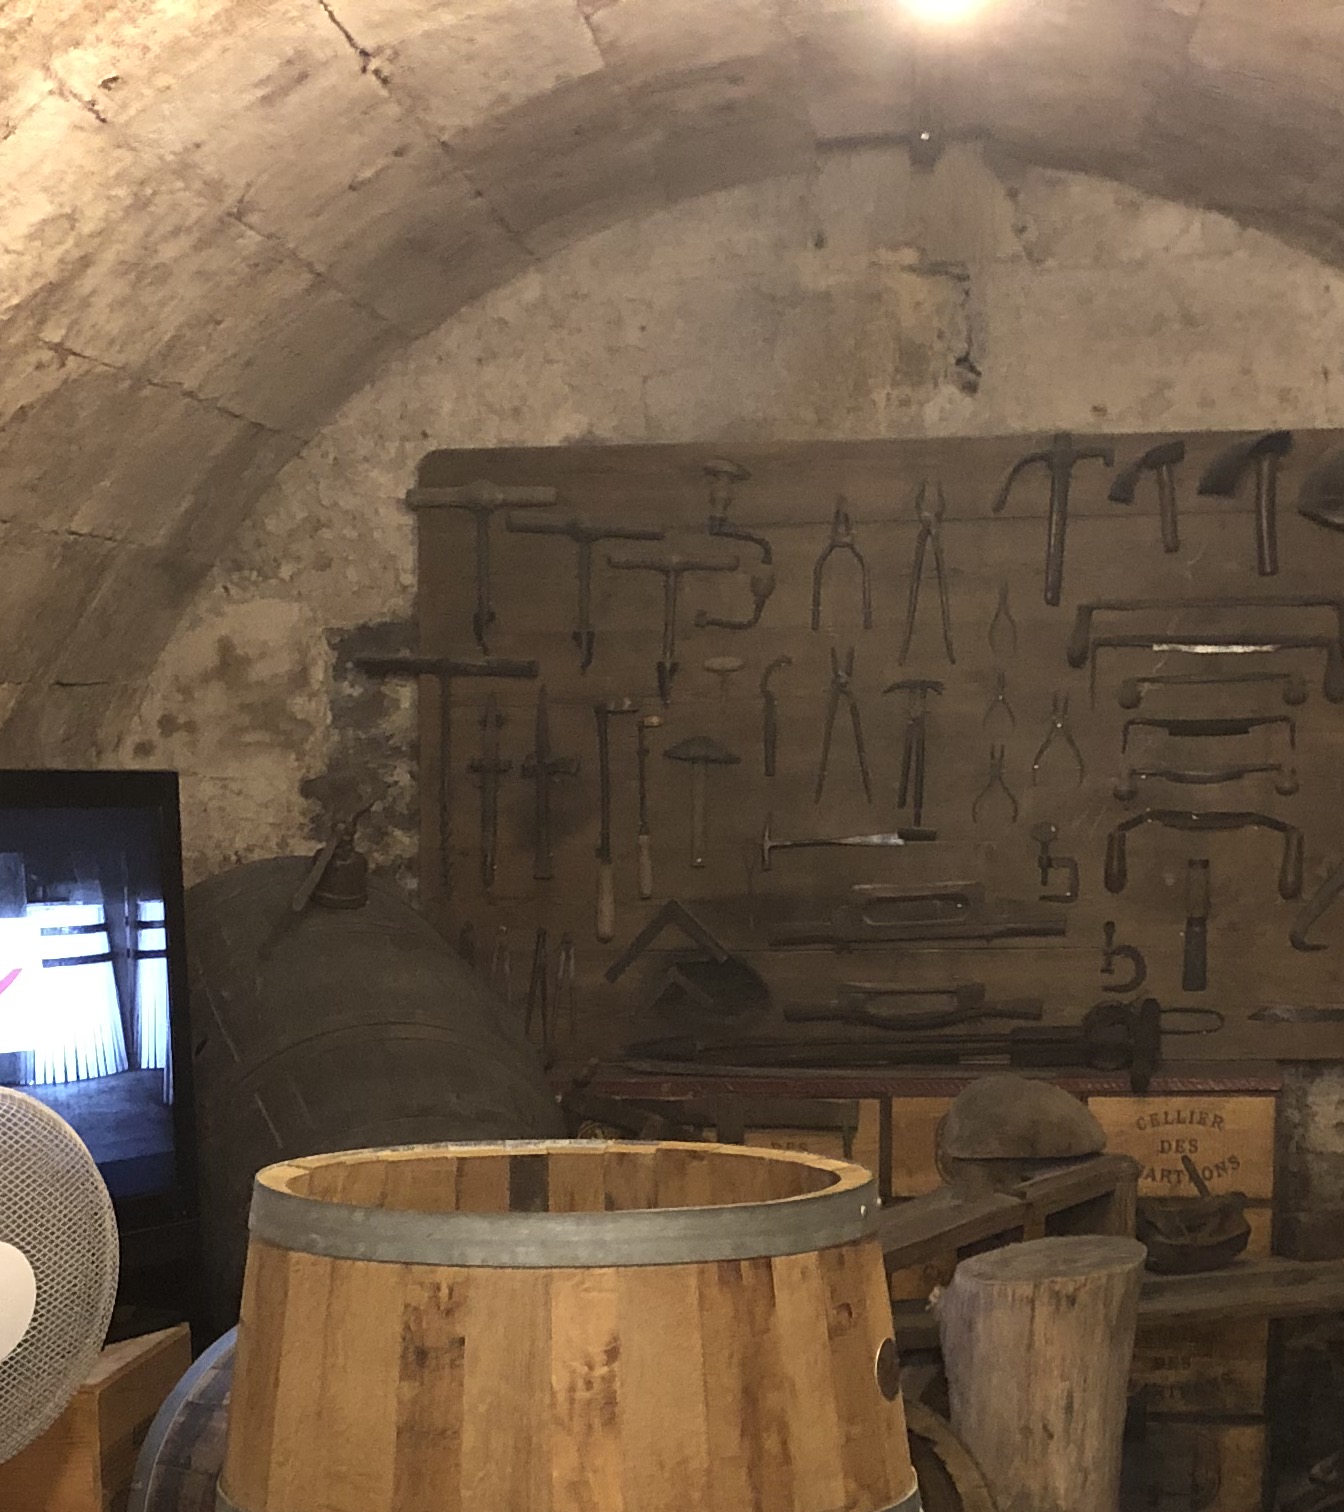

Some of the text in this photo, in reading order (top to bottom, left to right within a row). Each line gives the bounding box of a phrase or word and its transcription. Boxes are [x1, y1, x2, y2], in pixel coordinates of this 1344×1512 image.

[1136, 1110, 1225, 1131] CELLIER
[1159, 1139, 1199, 1154] DES
[1138, 1154, 1241, 1185] ARTONS
